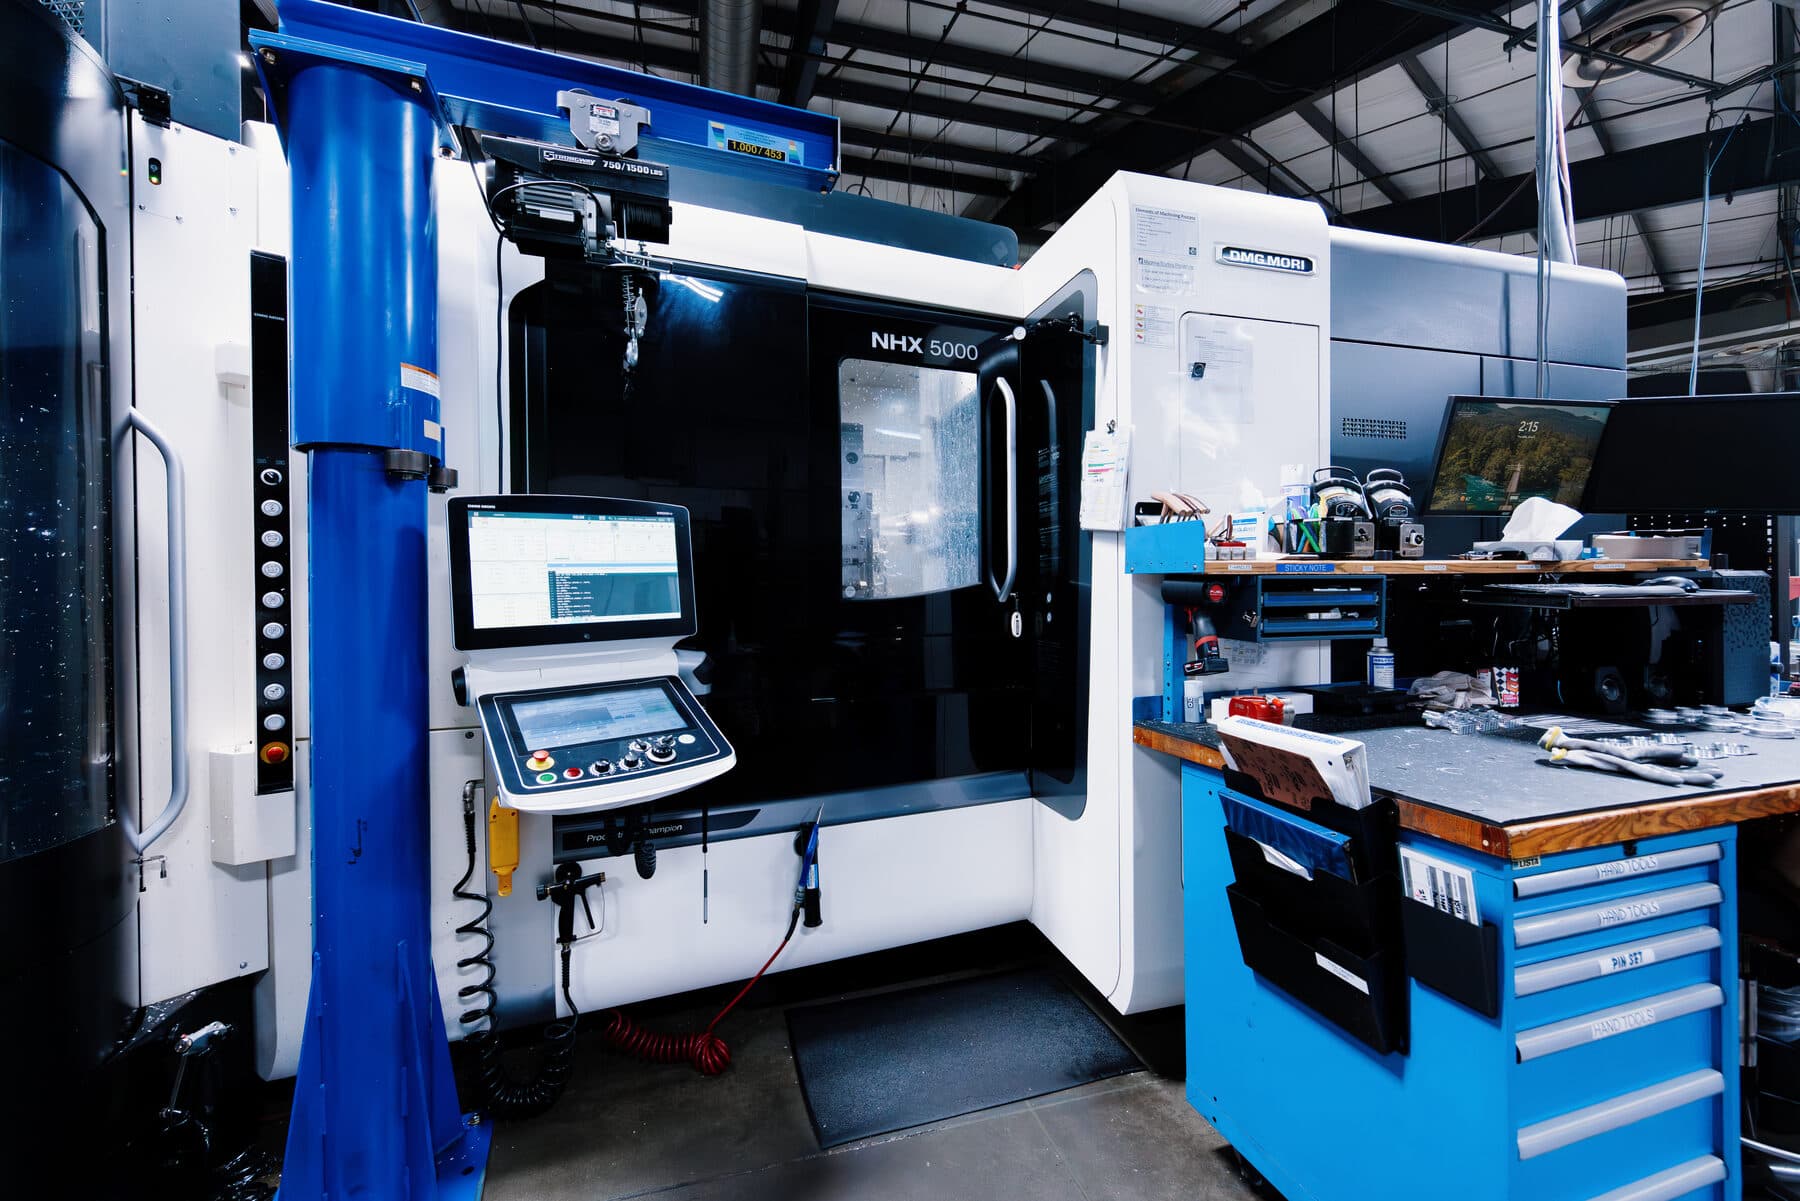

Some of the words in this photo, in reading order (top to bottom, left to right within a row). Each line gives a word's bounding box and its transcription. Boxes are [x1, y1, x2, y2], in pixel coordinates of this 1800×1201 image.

[764, 148, 782, 160] 453
[602, 160, 649, 175] 750/1500
[1266, 255, 1304, 270] MORI
[871, 331, 923, 354] NHX
[930, 340, 978, 361] 5000
[1518, 421, 1539, 432] 2:15
[1284, 564, 1308, 572] STICKY
[1309, 564, 1327, 572] NOTE
[1519, 857, 1539, 869] LISTA
[1600, 862, 1625, 878] HAND
[1627, 856, 1658, 873] TOOLS
[1600, 907, 1627, 925] HAND
[1627, 901, 1660, 918] TOOLS
[1611, 956, 1627, 970] PIN
[1628, 951, 1643, 966] SET
[1593, 1018, 1621, 1037] HAND
[1621, 1008, 1655, 1030] TOOLS
